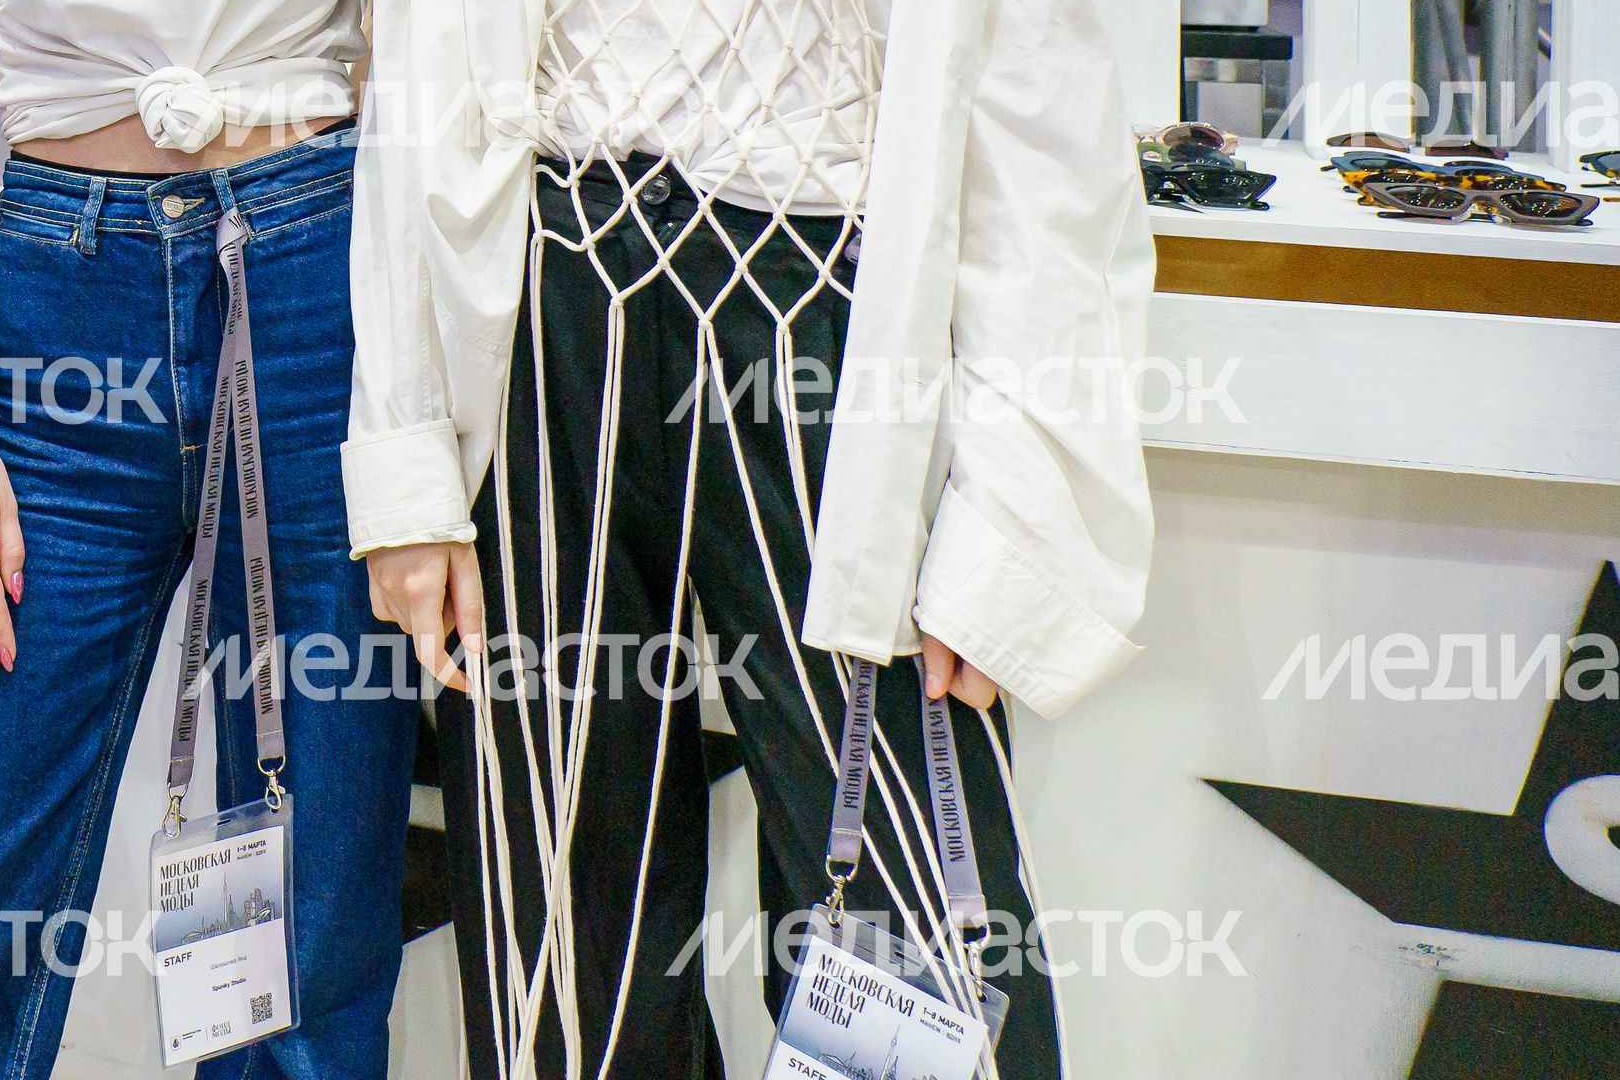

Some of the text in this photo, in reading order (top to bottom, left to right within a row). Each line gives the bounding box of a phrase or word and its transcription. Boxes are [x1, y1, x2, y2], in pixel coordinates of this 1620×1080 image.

[202, 376, 230, 539] МОСКОВСКАЯ НЕДЕЛЯ МОДЫ
[235, 359, 259, 519] МОСКОВСКАЯ НЕДЕЛЯ МОДЫ
[188, 579, 208, 656] МОСКОВСКАЯ
[250, 556, 273, 715] МОСКОВСКАЯ НЕДЕЛЯ МОДЫ
[178, 703, 193, 741] МОДЫ
[849, 711, 868, 762] НЕДЕЛЯ
[929, 710, 949, 762] НЕДЕЛЯ
[843, 767, 862, 809] МОДЫ
[934, 766, 966, 862] МОСКОВСКАЯ
[160, 848, 231, 880] МОСКОВСКАЯ
[160, 873, 199, 897] НЕДЕЛЯ
[160, 891, 194, 912] МОДЫ
[164, 951, 192, 967] STAFF
[811, 974, 866, 1013] НЕДЕЛЯ
[818, 953, 915, 1017] МОСКОВСКАЯ
[806, 991, 853, 1029] МОДЫ
[938, 1015, 964, 1035] МАРТА
[788, 1057, 827, 1080] STAFF
